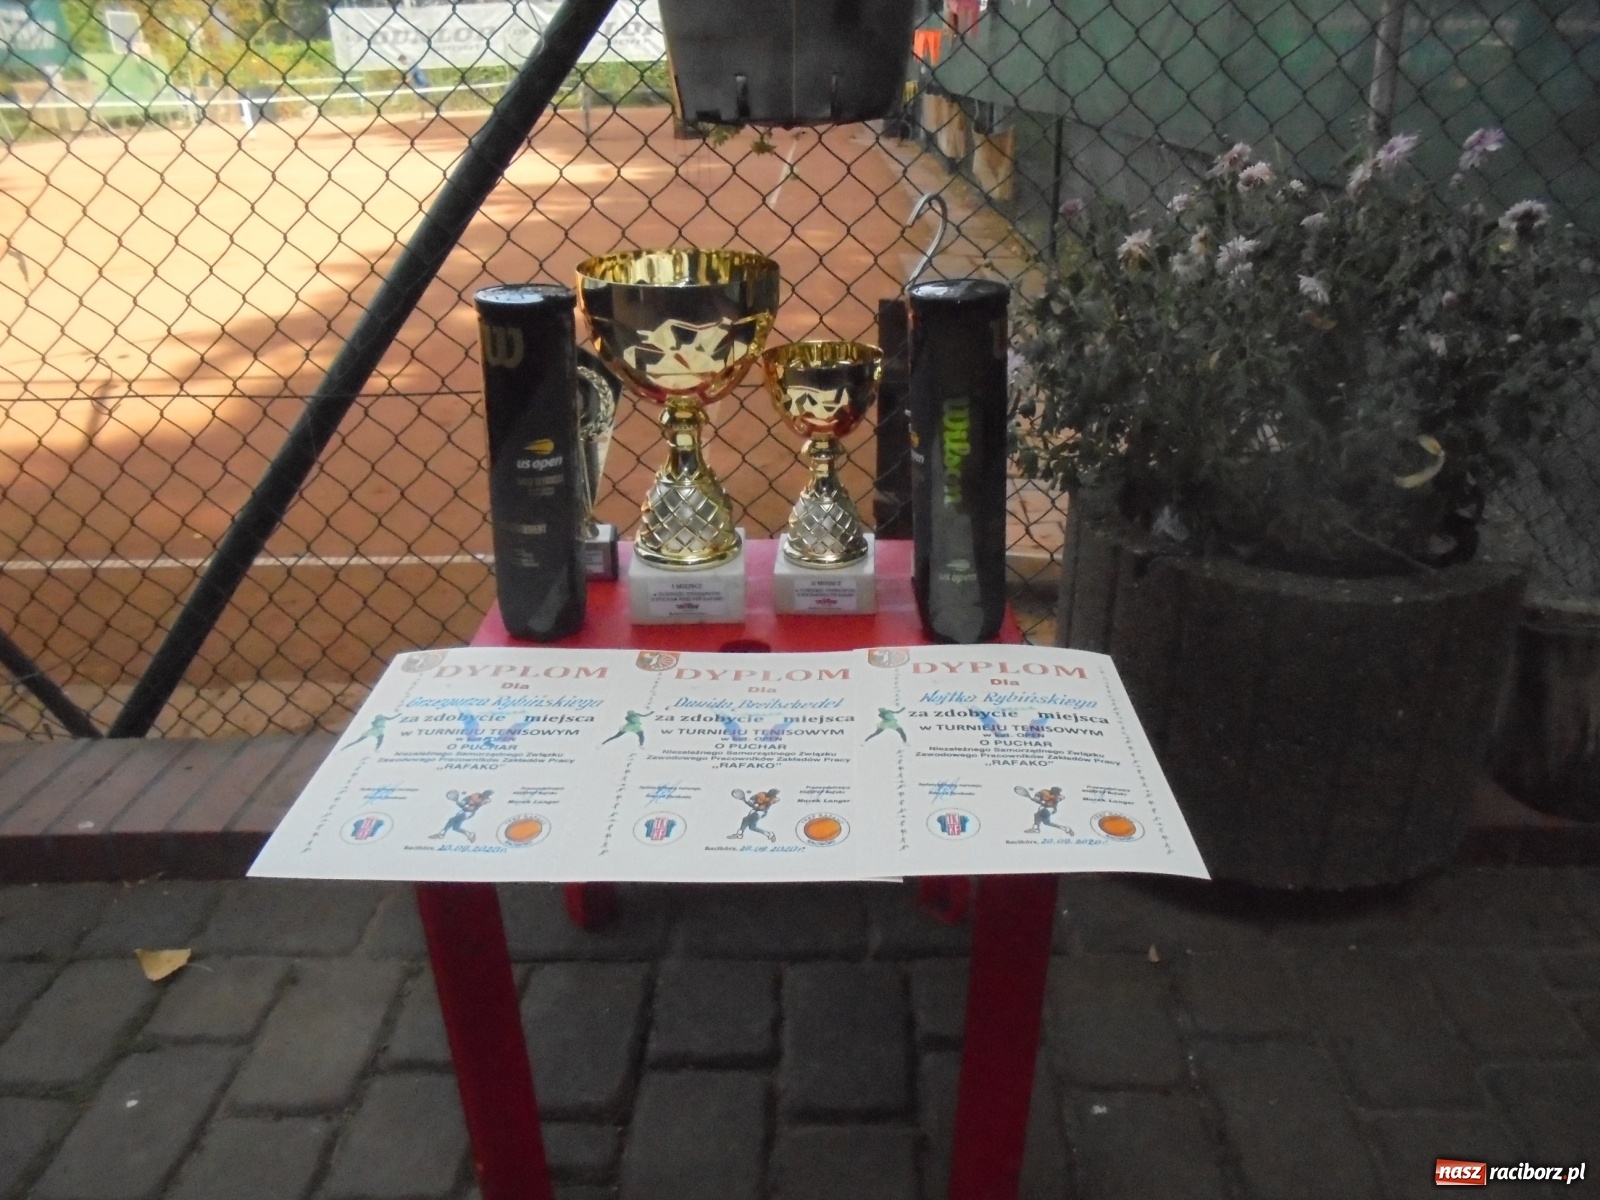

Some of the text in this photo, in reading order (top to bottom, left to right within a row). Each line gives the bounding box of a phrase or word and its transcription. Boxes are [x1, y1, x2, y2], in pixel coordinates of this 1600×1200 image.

[532, 457, 563, 471] open
[433, 664, 609, 679] DYPLOM
[674, 668, 851, 681] DYPLOM
[911, 661, 1089, 680] DYPLOM
[501, 682, 530, 690] Dla
[990, 678, 1020, 686] Dla
[399, 715, 419, 723] za
[423, 713, 506, 724] zdobycie
[524, 714, 595, 724] miejsca
[680, 713, 764, 723] zdobycie
[783, 715, 855, 725] miejsca
[908, 710, 928, 718] za
[933, 708, 1019, 720] zdobycie
[1037, 711, 1109, 725] miejsca
[417, 728, 485, 736] TURNIEJU
[490, 728, 580, 736] TENISOWYM
[678, 728, 748, 736] TURNIEJU
[753, 728, 845, 736] TENISOWYM
[936, 724, 1007, 732] TURNIEJU
[1011, 725, 1104, 737] TENISOWYM
[994, 740, 1053, 748] PUCHAR
